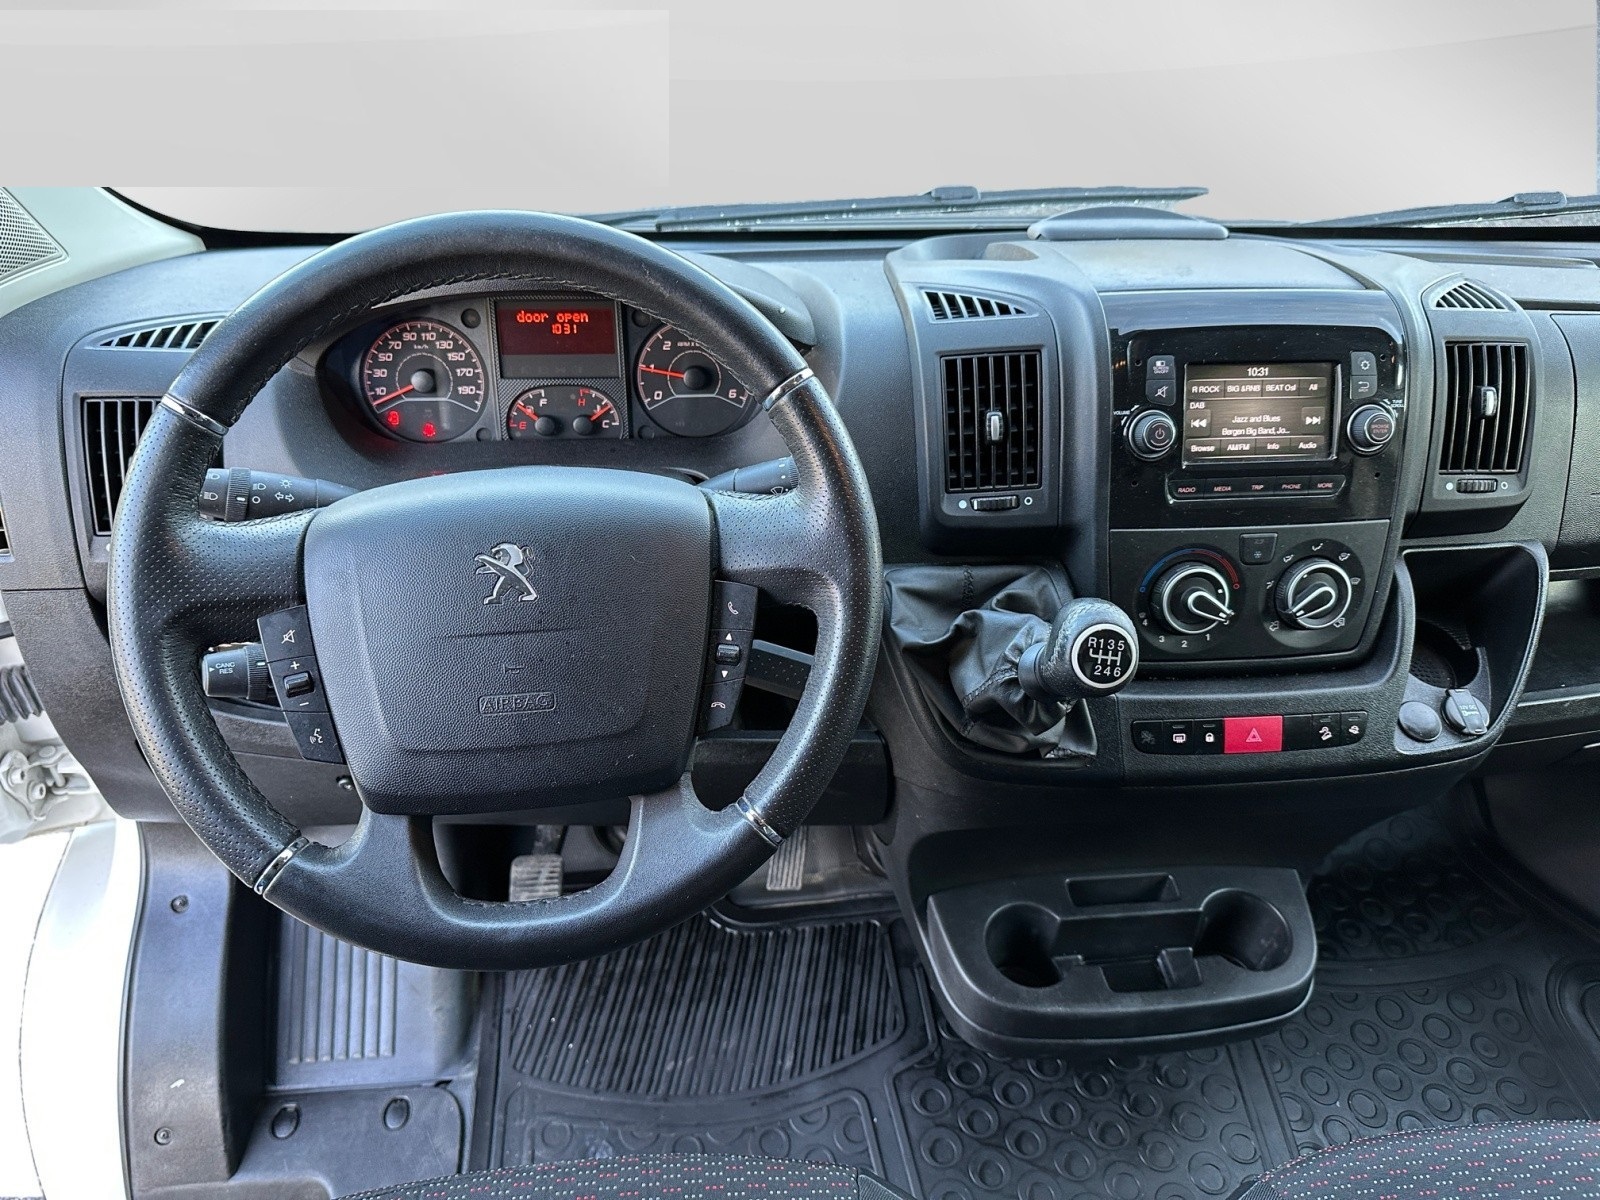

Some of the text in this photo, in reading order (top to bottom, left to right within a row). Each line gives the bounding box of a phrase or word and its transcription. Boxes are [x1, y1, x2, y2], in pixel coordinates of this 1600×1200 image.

[516, 310, 589, 323] door open
[403, 332, 417, 341] 90
[421, 332, 436, 341] 110
[388, 341, 402, 350] 70
[435, 341, 453, 349] 130
[662, 341, 672, 350] 2
[378, 353, 393, 361] 50
[447, 352, 465, 361] 150
[373, 369, 387, 377] 30
[456, 368, 473, 377] 170
[1247, 367, 1269, 376] 10:31
[375, 387, 387, 395] 10
[457, 386, 476, 395] 190
[1199, 385, 1220, 393] ROCK
[1226, 384, 1240, 393] BIG
[1265, 384, 1284, 392] BEAT
[1308, 383, 1318, 391] All
[654, 391, 662, 400] 0
[728, 389, 737, 399] 6
[539, 398, 548, 407] F
[578, 398, 586, 406] H
[602, 420, 610, 428] C
[1232, 415, 1249, 424] Jazz
[1249, 415, 1262, 423] and
[518, 421, 527, 429] E
[1221, 428, 1245, 437] Bergen
[1245, 427, 1257, 436] Big
[1266, 442, 1280, 450] Info
[1158, 635, 1165, 643] 3
[1205, 633, 1211, 641] 1
[1181, 640, 1188, 648] 2
[481, 694, 549, 712] AIRBAG
